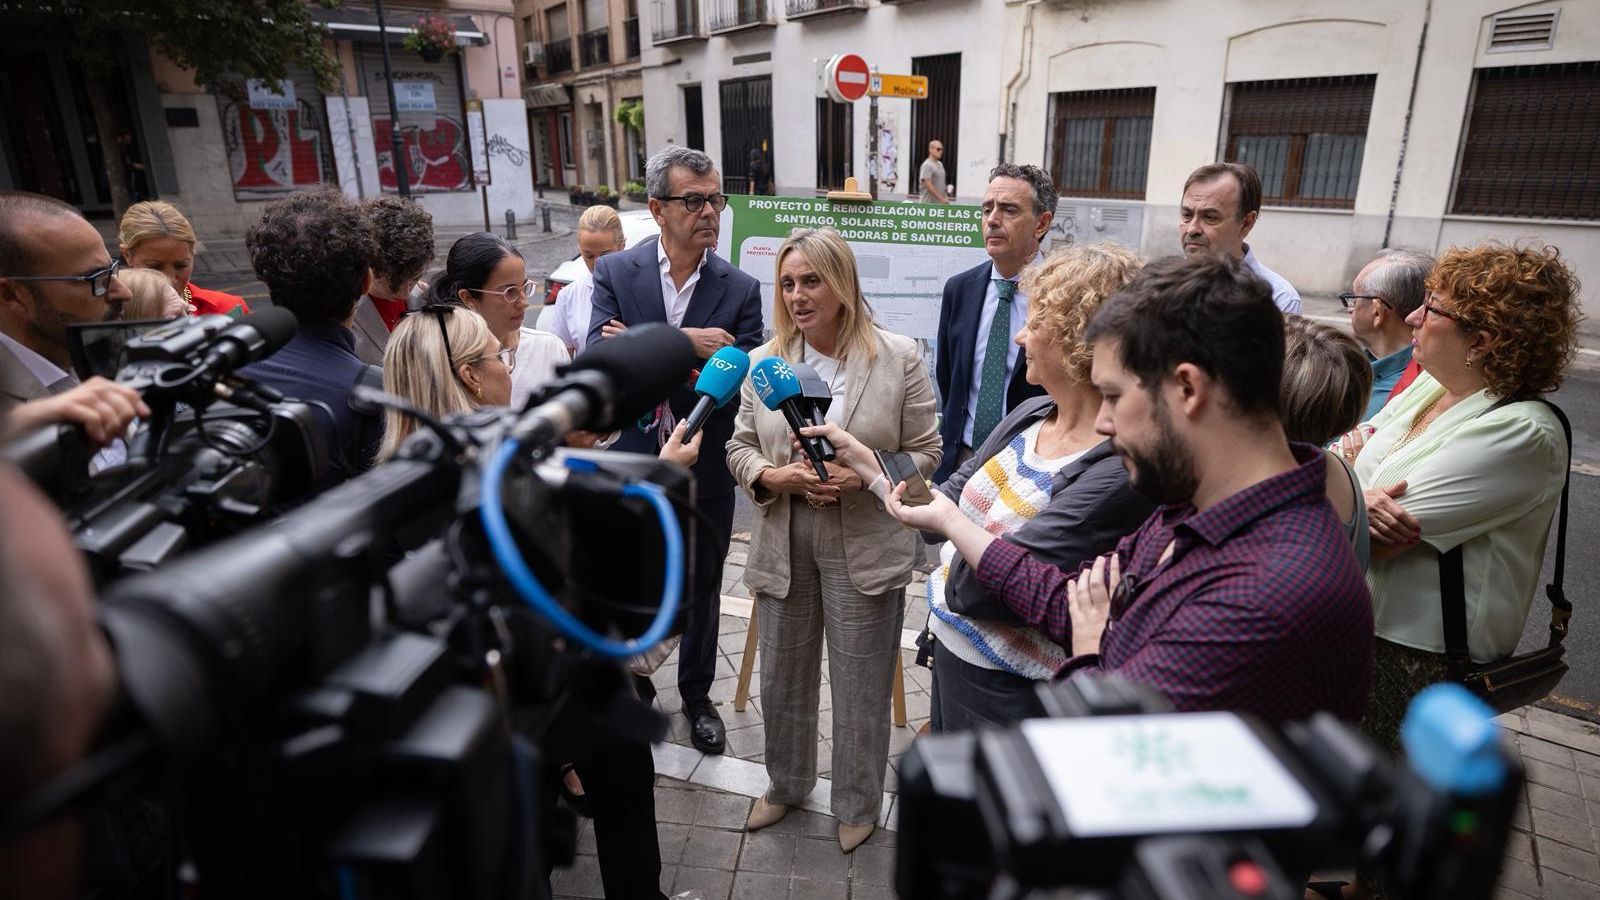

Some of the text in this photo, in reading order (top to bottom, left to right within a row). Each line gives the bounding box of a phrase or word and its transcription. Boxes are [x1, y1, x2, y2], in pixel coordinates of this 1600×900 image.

[749, 199, 812, 212] PROYECTO
[814, 203, 830, 213] DE
[832, 203, 926, 218] REMODELACIÓN
[929, 208, 945, 218] DE
[947, 209, 971, 220] LAS
[774, 213, 979, 233] SANTIAGO, SOLARES, SOMOSIERRA
[892, 231, 908, 242] DE
[910, 232, 972, 245] SANTIAGO
